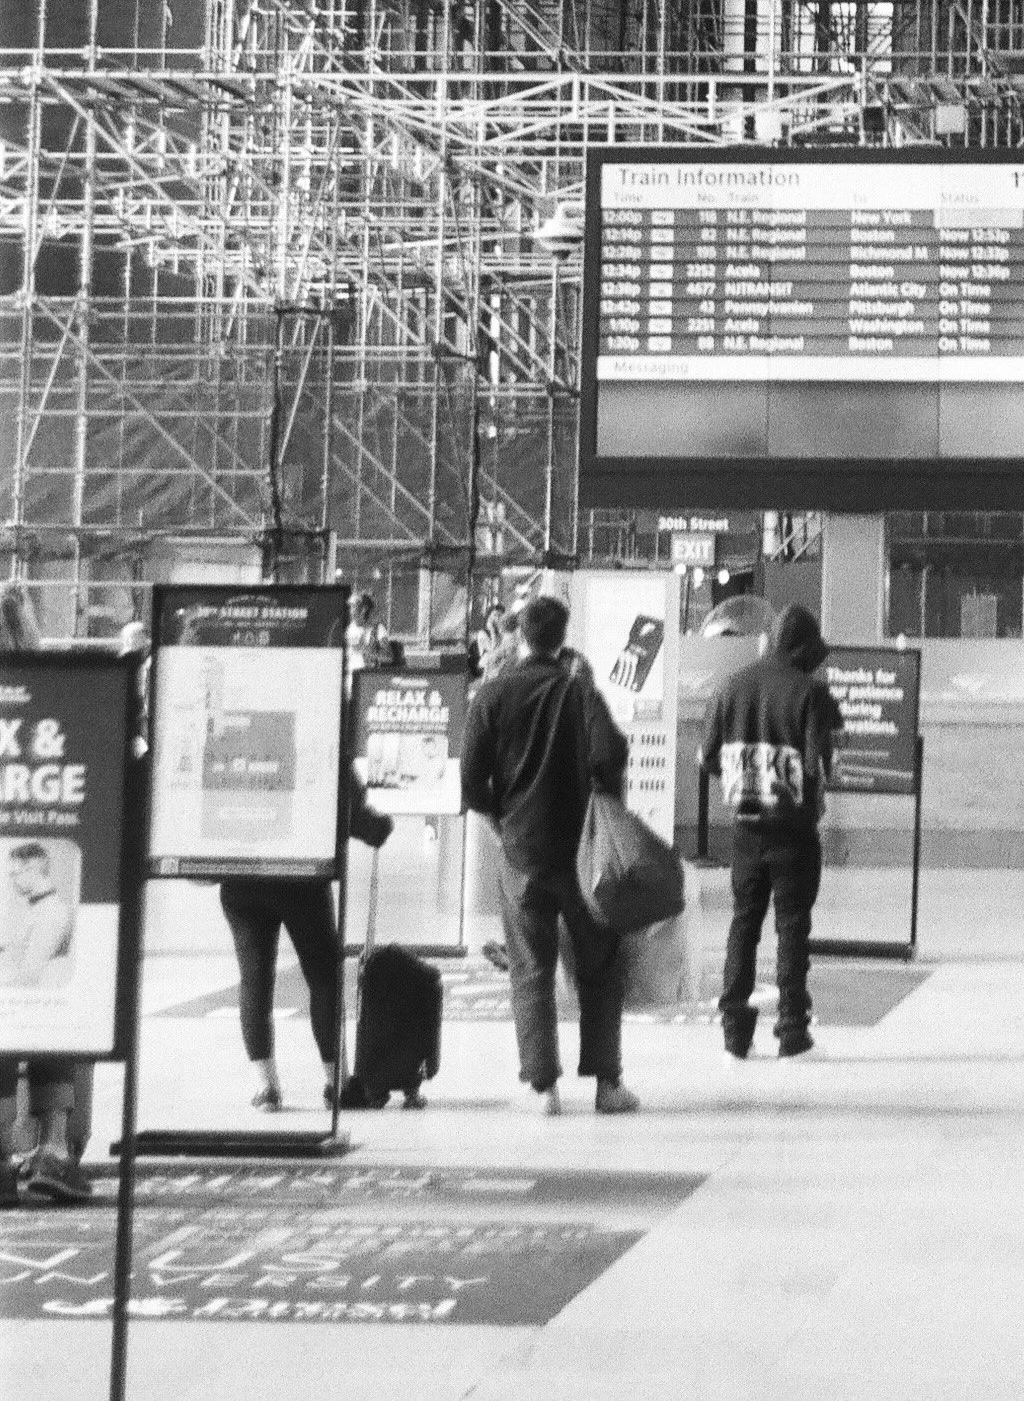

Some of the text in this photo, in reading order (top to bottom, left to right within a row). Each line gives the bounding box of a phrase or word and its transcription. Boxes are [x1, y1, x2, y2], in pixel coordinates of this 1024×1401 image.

[619, 168, 800, 186] Train Information
[614, 192, 643, 203] Time
[729, 192, 759, 202] Train
[941, 192, 979, 203] Status
[753, 212, 806, 226] Regional
[851, 213, 879, 224] New
[883, 212, 911, 224] York
[752, 229, 806, 244] Regional
[851, 230, 895, 241] Boston
[940, 230, 968, 241] Now
[752, 247, 805, 261] Regional
[850, 247, 912, 260] Richmond
[940, 248, 968, 259] Now
[725, 265, 759, 277] Acela
[850, 265, 894, 278] Boston
[940, 266, 968, 277] Now
[850, 283, 898, 297] Atlantic
[901, 283, 926, 298] City
[939, 283, 957, 296] On
[961, 283, 990, 296] Time
[725, 301, 813, 316] Pennsylvanian
[849, 302, 914, 317] Pittsburgh
[939, 302, 957, 315] On
[961, 302, 990, 315] Time
[724, 319, 759, 331] Acela
[849, 320, 923, 335] Washington
[939, 320, 957, 333] On
[961, 320, 990, 333] Time
[750, 337, 804, 352] Regional
[849, 338, 892, 351] Boston
[939, 338, 957, 351] On
[960, 338, 990, 351] Time
[614, 361, 689, 375] Messaging
[659, 517, 729, 532] 30th Street
[674, 540, 712, 560] EXIT
[220, 607, 259, 619] STREET
[262, 608, 309, 619] STATION
[826, 667, 896, 685] Thanks for
[376, 690, 442, 706] RELAX &
[849, 685, 904, 700] patience
[367, 706, 450, 723] RECHARGE
[839, 700, 882, 719] during
[33, 717, 66, 757] &
[0, 764, 86, 804] RGE
[0, 1270, 489, 1289] NVERSITY
